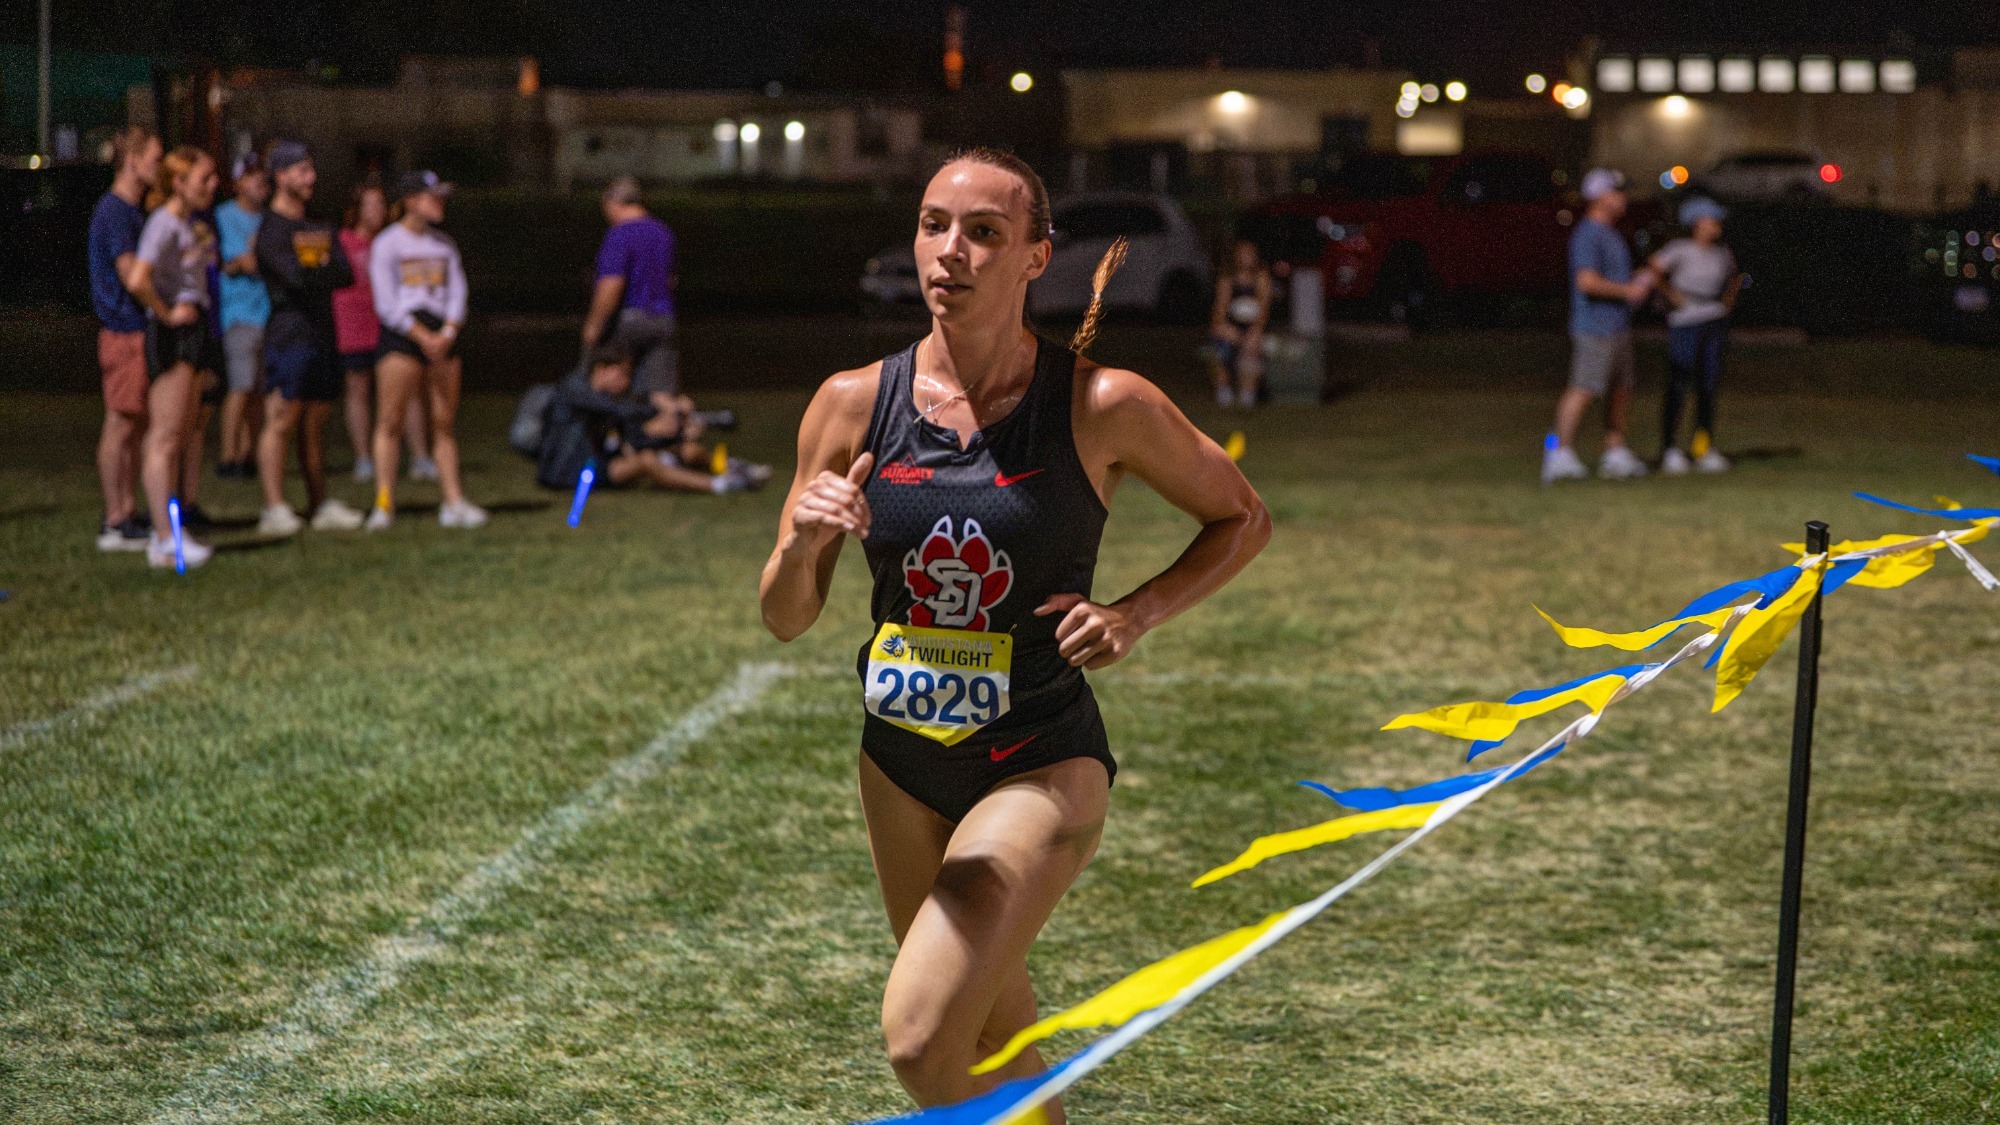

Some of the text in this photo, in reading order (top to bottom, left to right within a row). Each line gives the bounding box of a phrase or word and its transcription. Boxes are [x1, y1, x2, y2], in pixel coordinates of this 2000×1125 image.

[880, 466, 935, 480] SUMMIT
[908, 634, 993, 653] AUGUSTANA
[908, 645, 993, 668] TWILIGHT
[877, 667, 1000, 725] 2829
